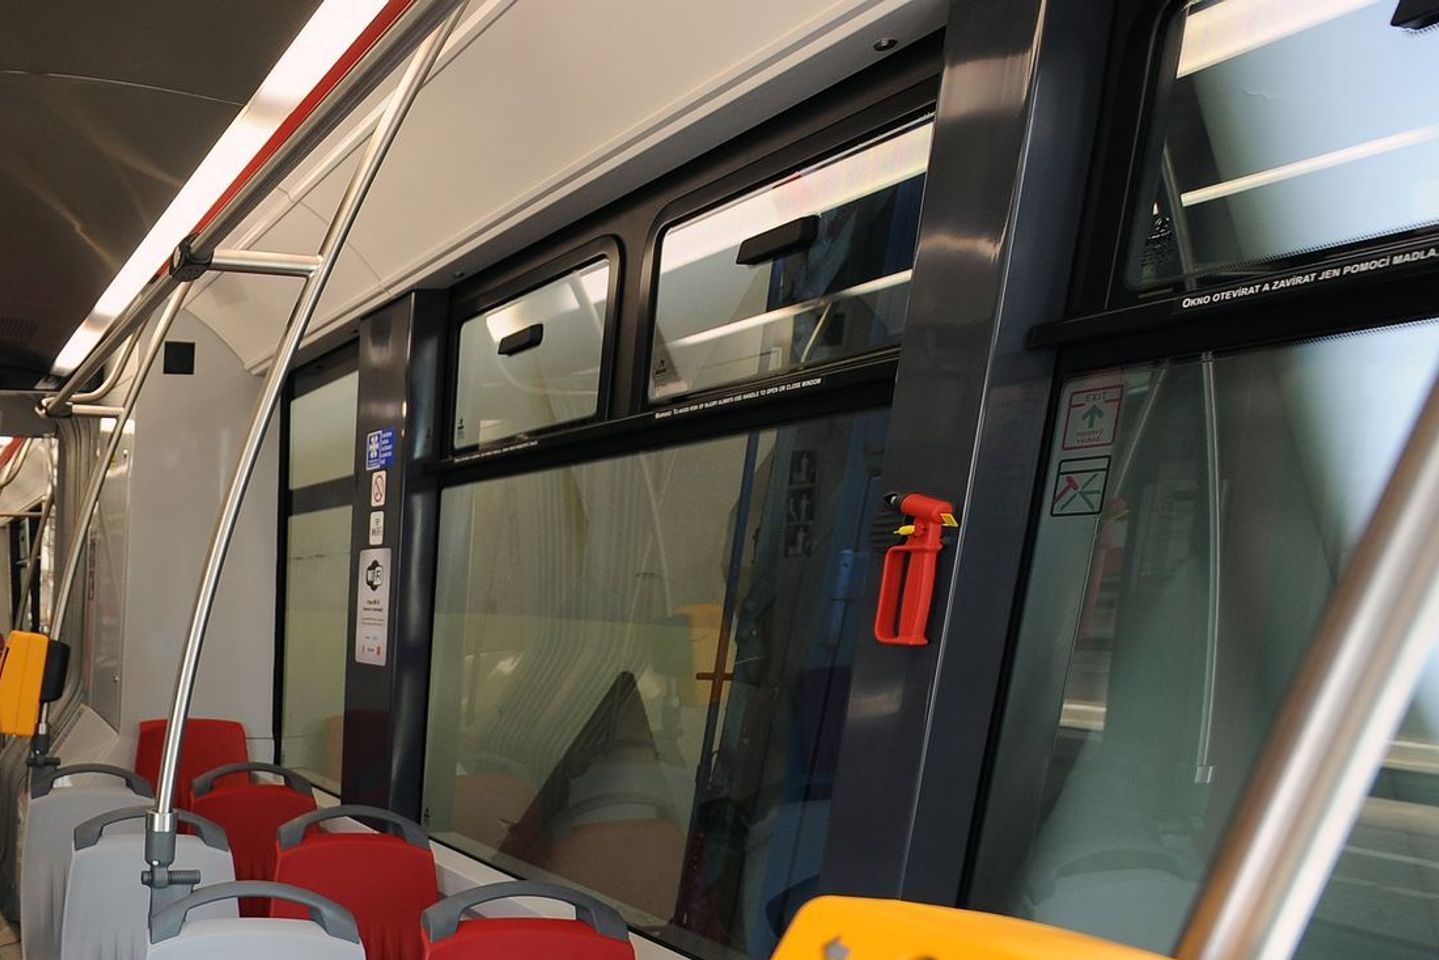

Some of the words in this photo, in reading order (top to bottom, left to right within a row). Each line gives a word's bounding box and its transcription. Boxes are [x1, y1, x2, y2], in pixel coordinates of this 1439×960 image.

[1212, 284, 1262, 303] OTEVÍRAT
[1261, 283, 1271, 292] A
[1271, 272, 1317, 291] ZAVÍRAT
[1318, 267, 1341, 280] JEN
[1342, 255, 1391, 275] POMOCÍ
